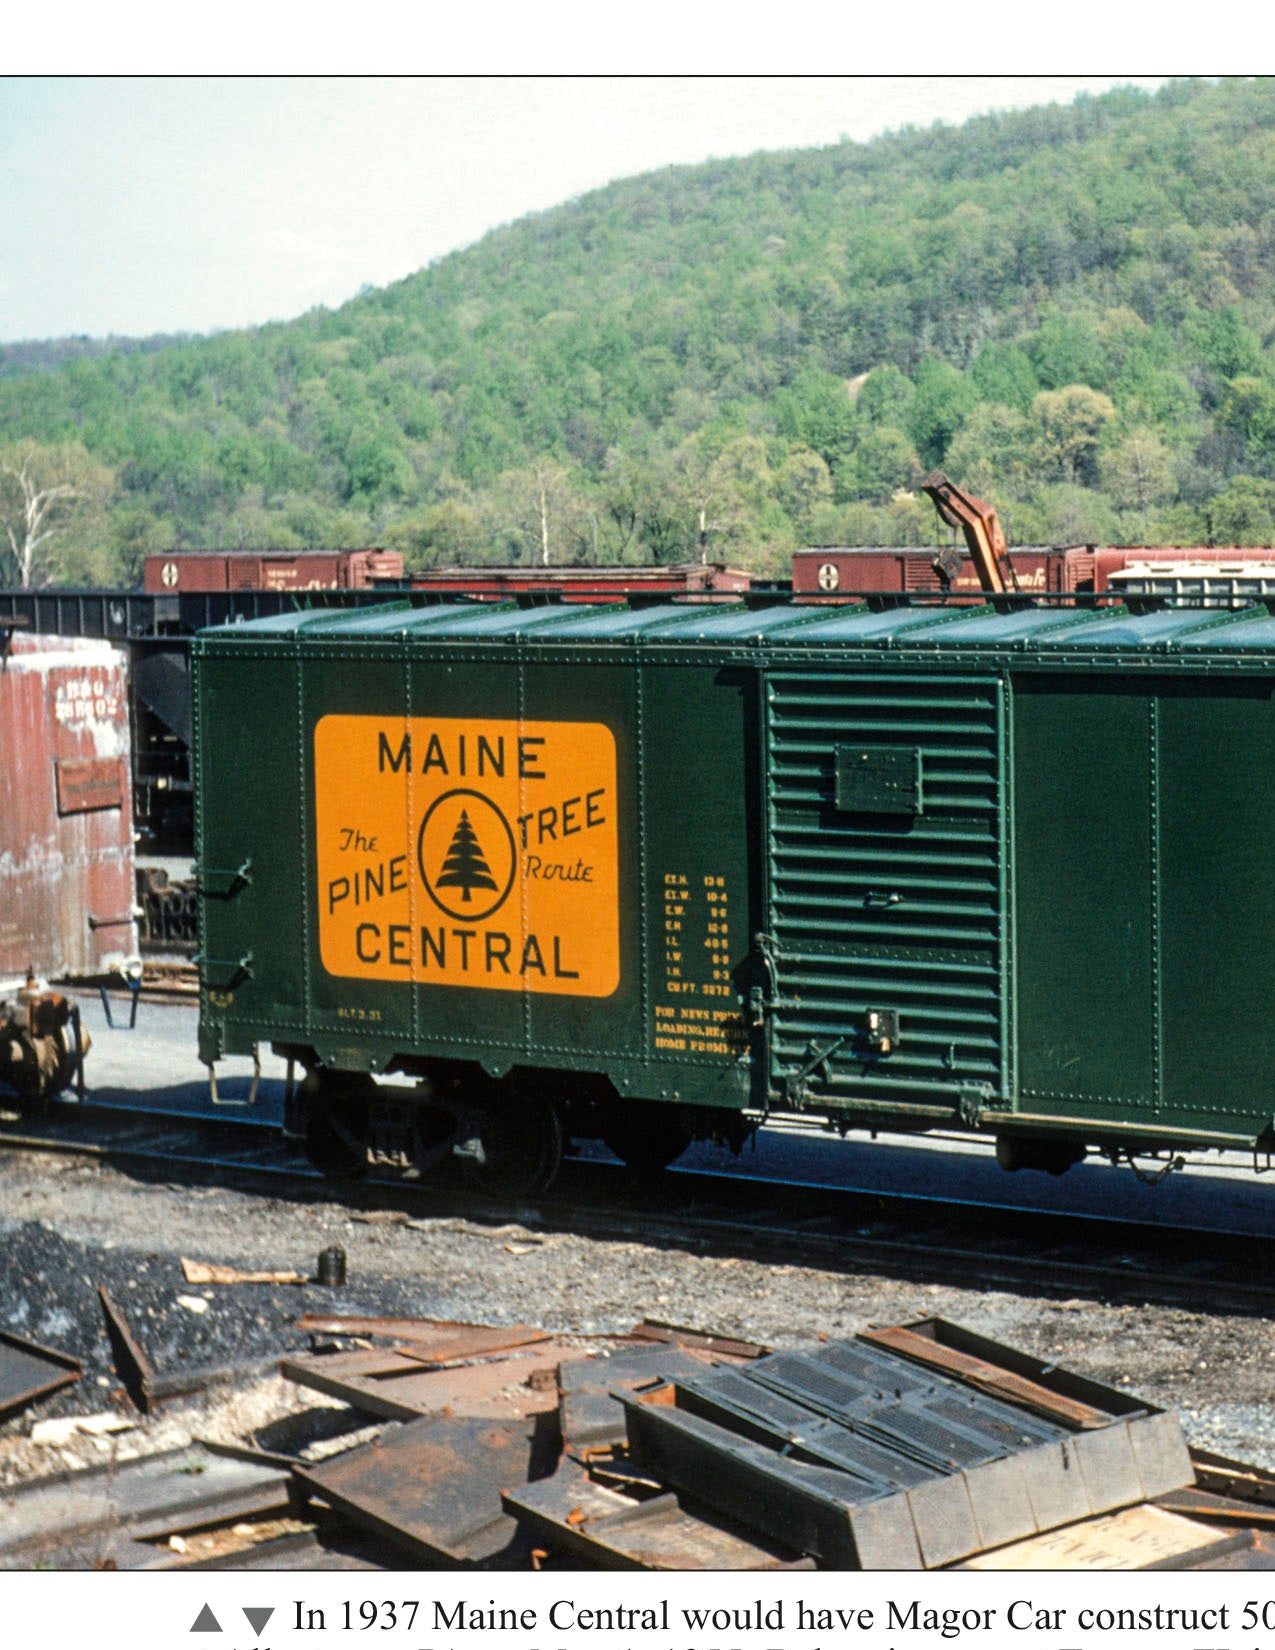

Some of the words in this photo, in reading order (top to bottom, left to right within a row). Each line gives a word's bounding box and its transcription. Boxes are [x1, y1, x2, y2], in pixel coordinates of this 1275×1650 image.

[376, 730, 548, 782] MAINE
[338, 828, 379, 853] The
[516, 787, 606, 850] TREE
[328, 854, 408, 915] PINE
[525, 855, 594, 882] Route
[355, 922, 580, 980] CENTRAL
